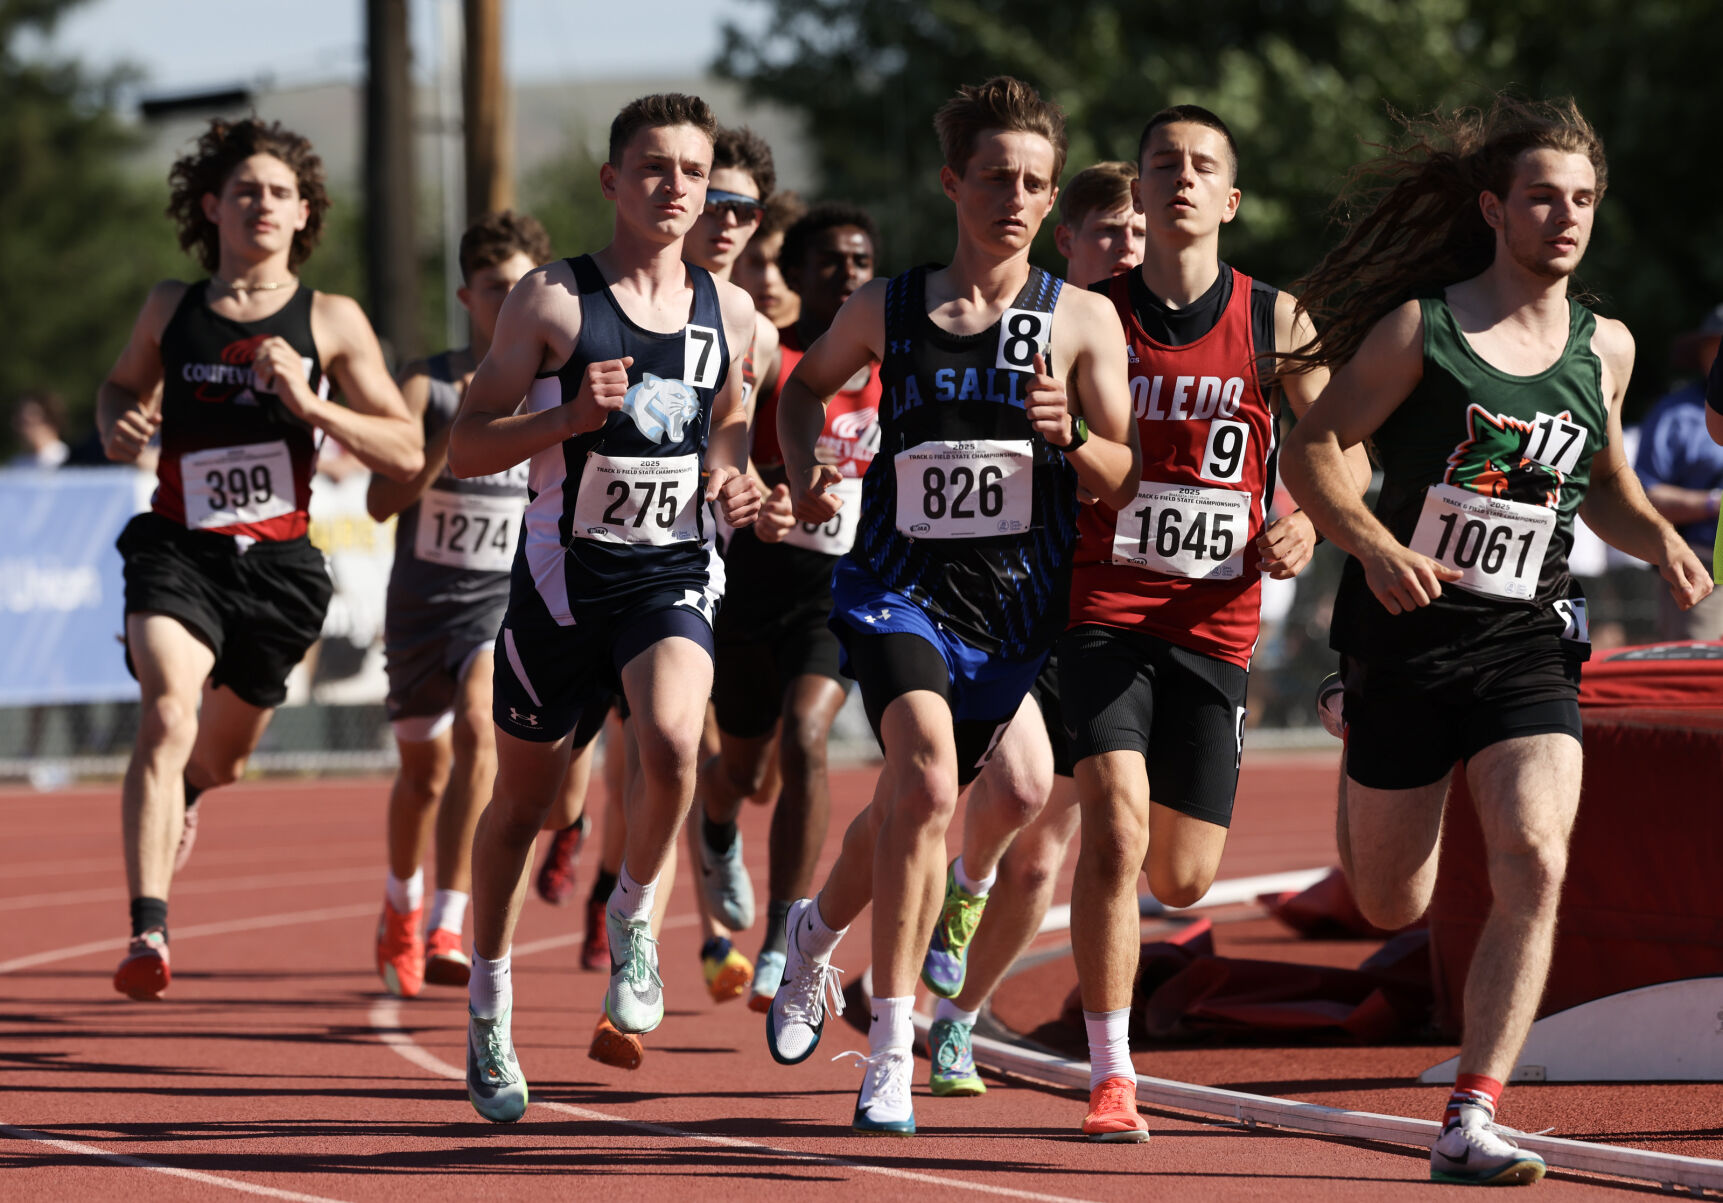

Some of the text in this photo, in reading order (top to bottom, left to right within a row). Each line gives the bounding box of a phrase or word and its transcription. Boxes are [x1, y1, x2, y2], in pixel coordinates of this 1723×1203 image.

[690, 329, 714, 383] 7
[1003, 313, 1042, 367] 8
[891, 367, 1027, 420] LA SALL
[1130, 375, 1245, 420] OLEDO
[1209, 425, 1244, 479] 9
[1533, 418, 1580, 467] 17
[206, 464, 272, 511] 399
[596, 466, 615, 474] TRACK
[655, 466, 693, 475] CHAMPIONSHIPS
[923, 465, 1003, 519] 826
[1178, 487, 1201, 496] 2025
[602, 480, 679, 529] 275
[1195, 499, 1241, 508] CHAMPIONSHIPS
[1442, 497, 1461, 508] TRACK
[1469, 505, 1484, 514] FIELD
[1485, 509, 1502, 518] STATE
[1502, 512, 1548, 525] CHAMPIONSHIPS
[1489, 501, 1511, 510] 2025
[433, 511, 509, 554] 1274
[1135, 506, 1234, 561] 1645
[1434, 512, 1536, 579] 1061
